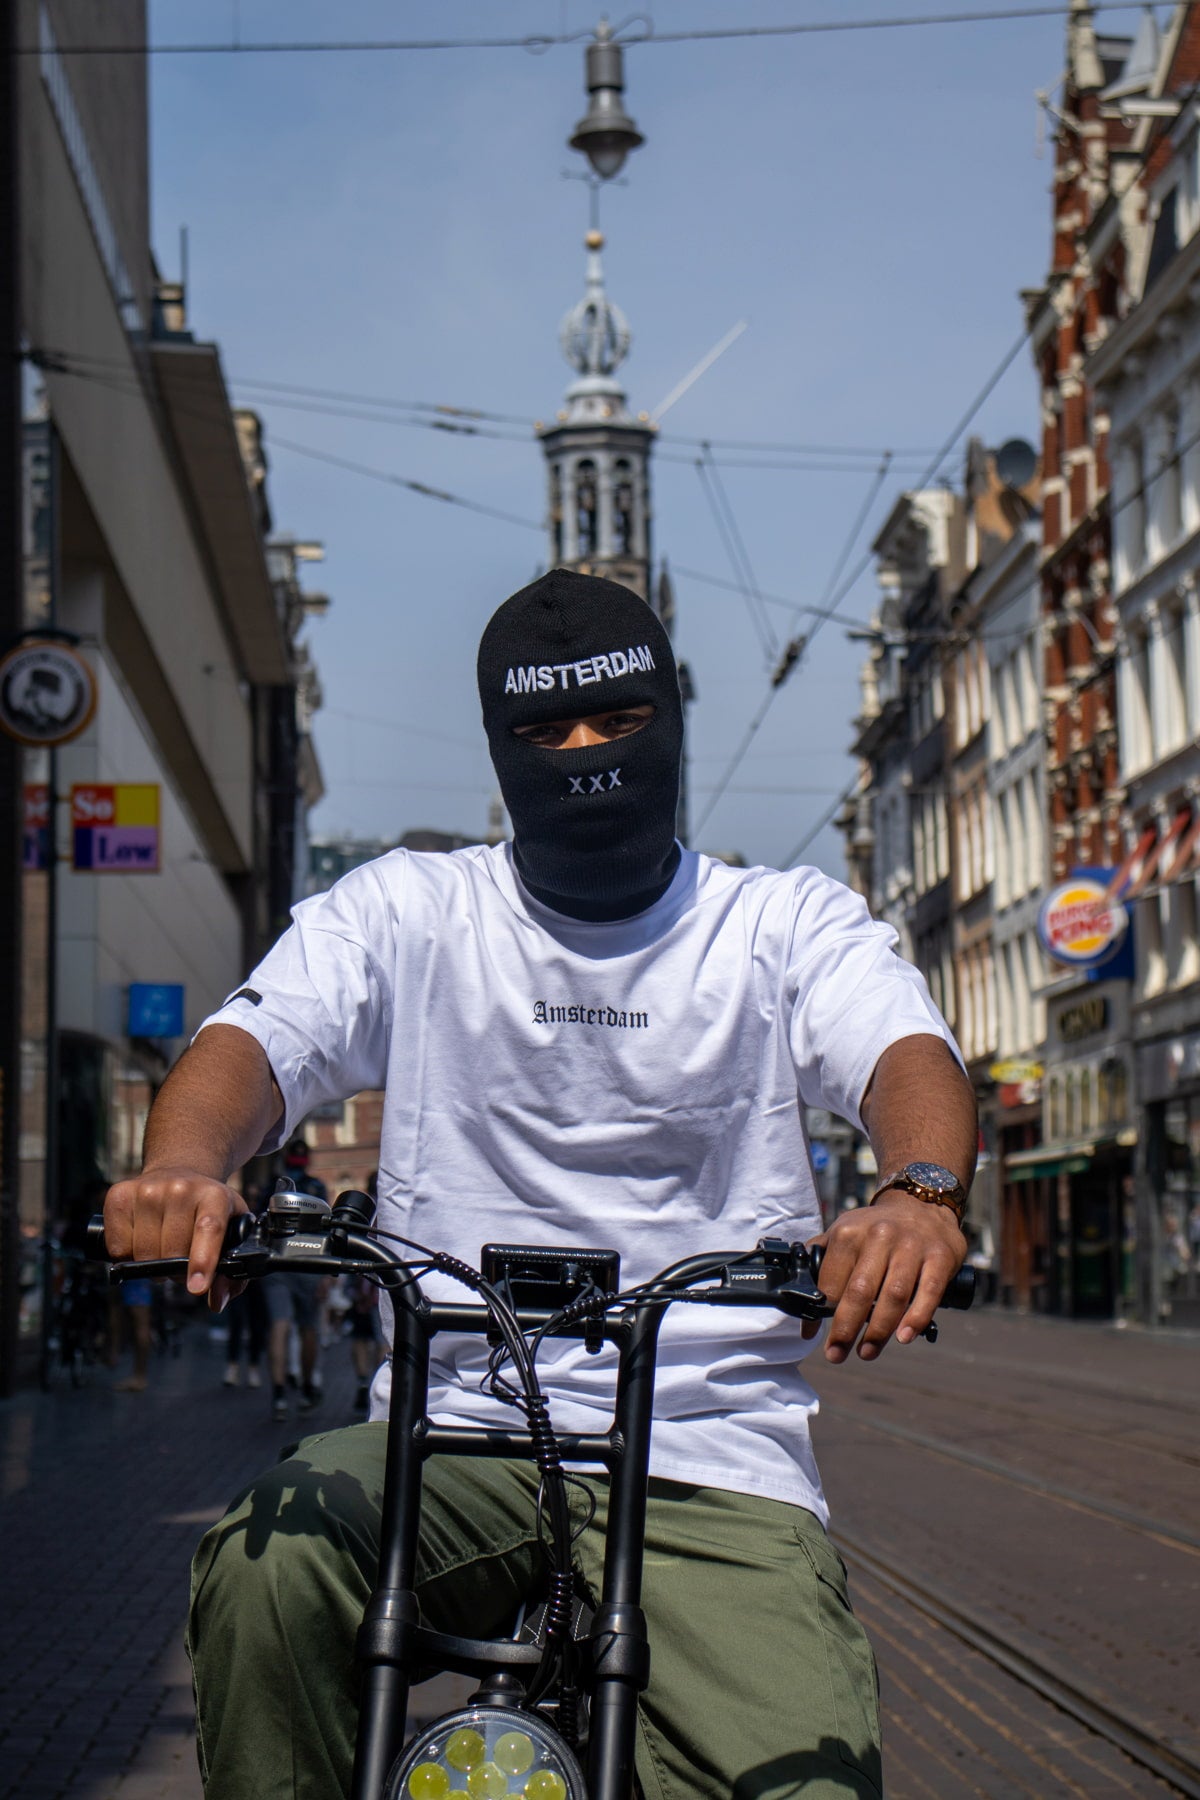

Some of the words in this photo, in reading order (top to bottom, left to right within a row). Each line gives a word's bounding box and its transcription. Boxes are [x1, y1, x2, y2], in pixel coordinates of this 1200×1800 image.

[504, 645, 656, 694] AMSTERDAM
[73, 790, 113, 821] So
[97, 835, 156, 864] Low
[1050, 911, 1112, 946] KING
[532, 1000, 649, 1028] Amsterdam
[287, 1240, 322, 1249] TEKTRO
[730, 1273, 768, 1281] TEKTRO
